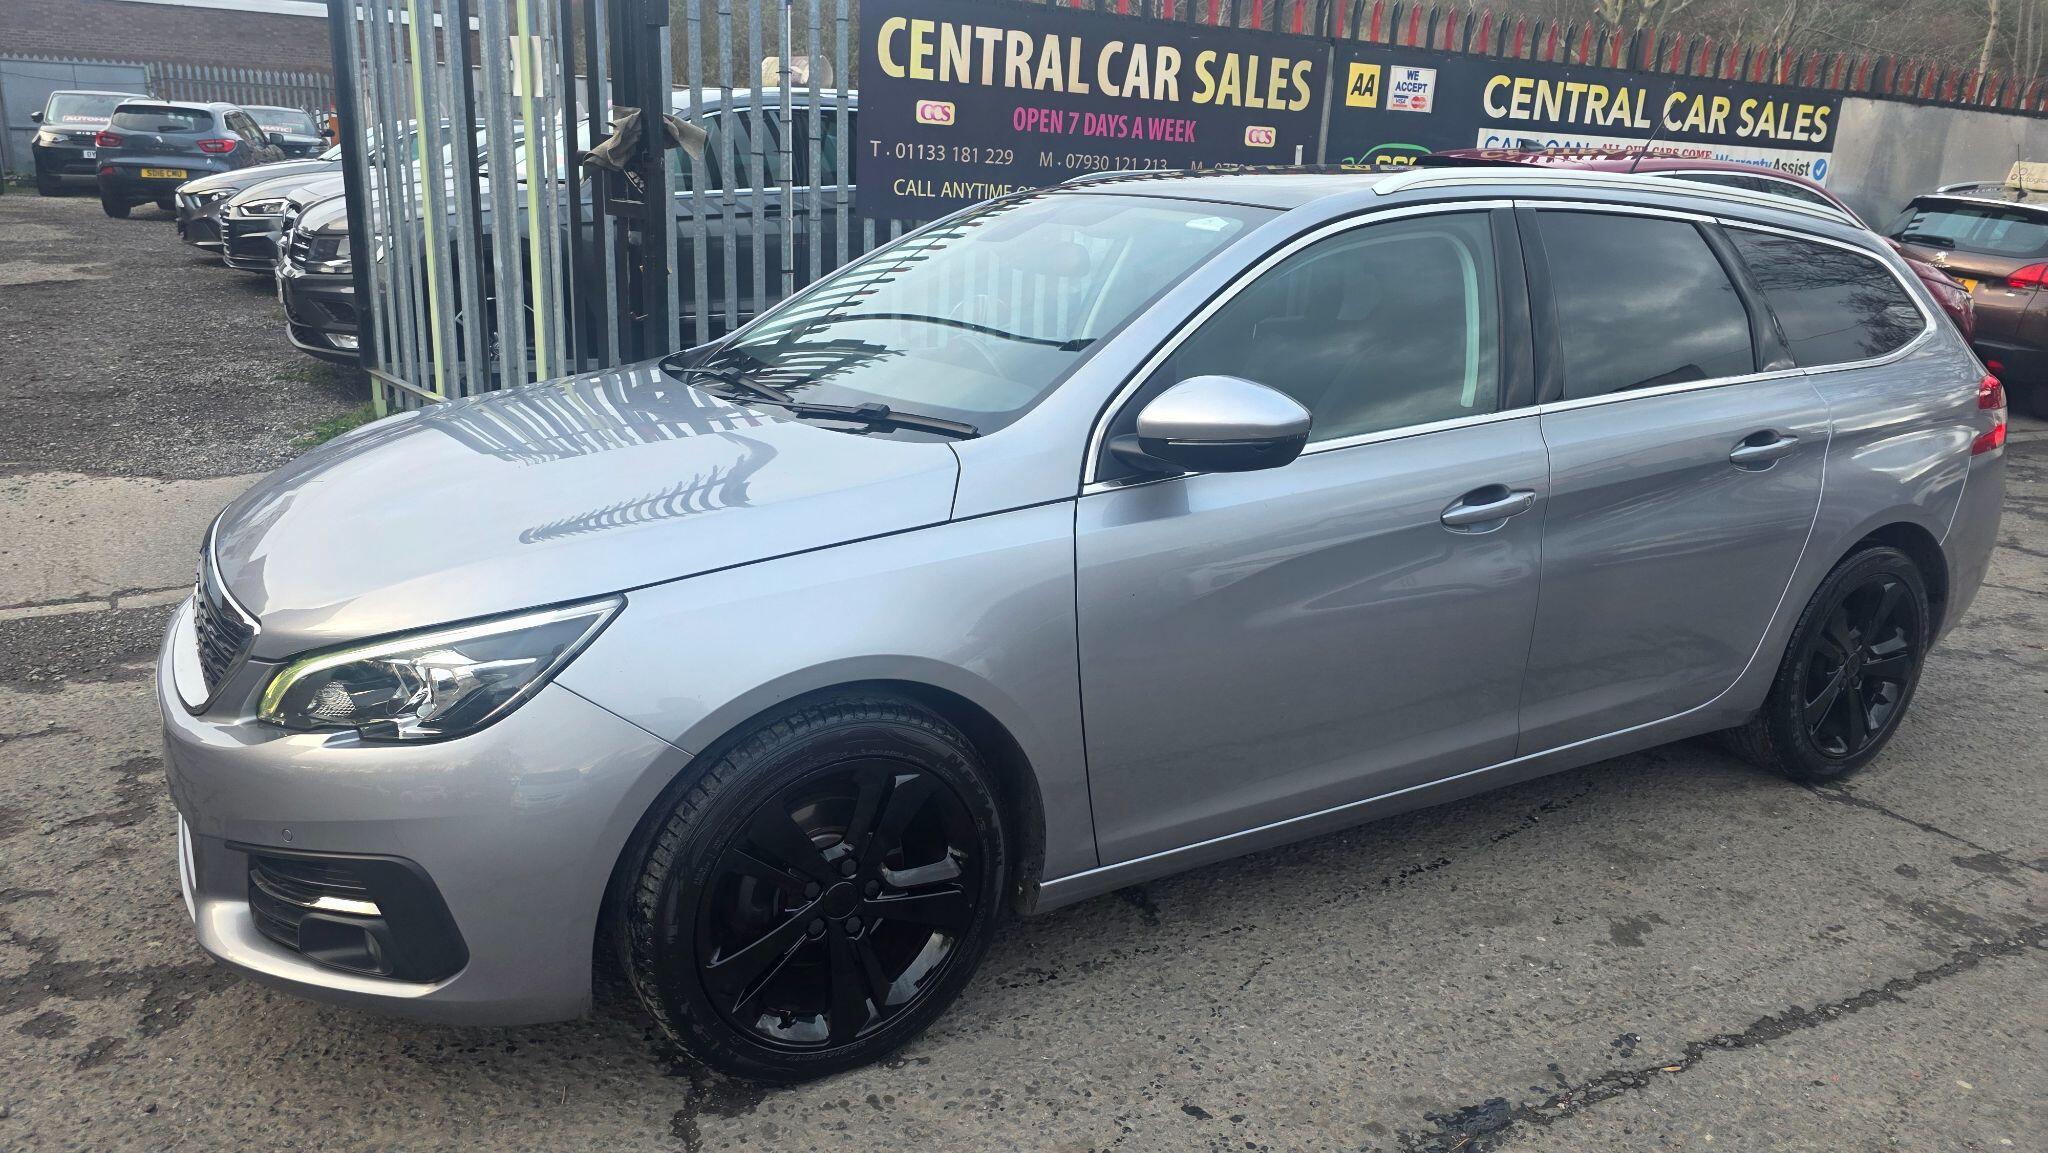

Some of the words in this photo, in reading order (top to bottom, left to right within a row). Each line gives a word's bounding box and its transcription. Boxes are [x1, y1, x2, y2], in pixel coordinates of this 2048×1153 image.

[877, 16, 1090, 95] CENTRAL
[1097, 41, 1181, 102] CAR
[1191, 50, 1313, 112] SALES
[1407, 69, 1420, 81] WE
[1350, 72, 1376, 97] AA
[1395, 81, 1428, 94] ACCEPT
[1483, 74, 1651, 128] CENTRAL
[1663, 91, 1731, 135] CAR
[1736, 98, 1832, 144] SALES
[1013, 106, 1064, 134] OPEN
[1068, 111, 1080, 135] 7
[1083, 112, 1128, 138] DAYS
[1131, 116, 1144, 139] A
[1148, 117, 1197, 143] WEEK
[895, 142, 946, 161] 01133
[952, 146, 978, 163] 181
[984, 149, 1014, 165] 229
[1065, 153, 1109, 171] 07930
[1115, 156, 1138, 171] 121
[1143, 158, 1168, 171] 213
[1682, 148, 1713, 158] COME
[1773, 158, 1811, 177] Assist
[893, 178, 936, 198] CALL
[940, 181, 1012, 200] ANYTIME
